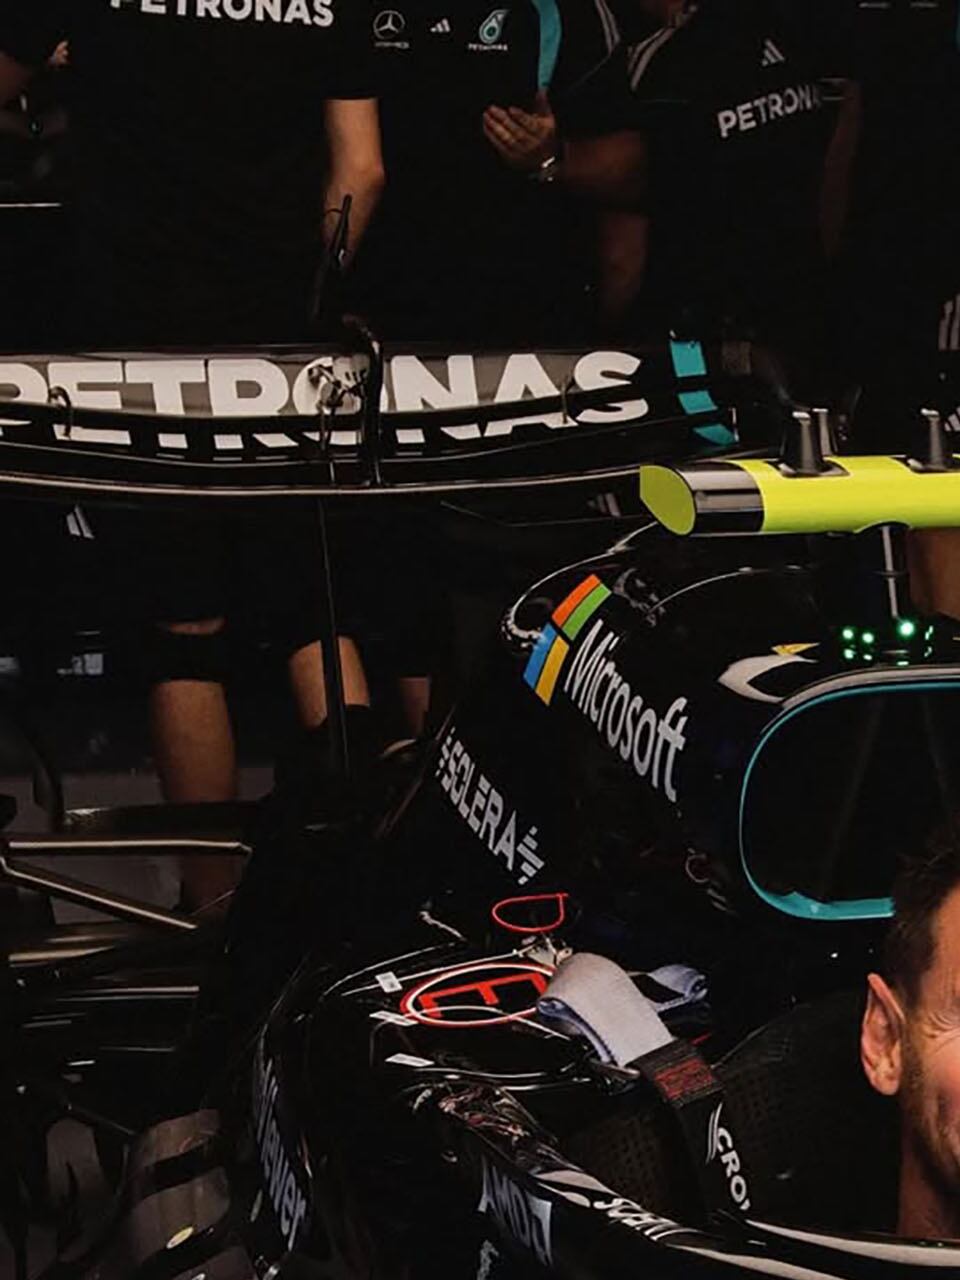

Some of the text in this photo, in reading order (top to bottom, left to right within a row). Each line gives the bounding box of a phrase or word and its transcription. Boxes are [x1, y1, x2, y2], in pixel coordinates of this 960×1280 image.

[110, 0, 334, 27] ETRONAS
[717, 83, 820, 138] PETRON
[563, 618, 688, 802] Microsoft
[440, 738, 517, 872] SOLERA
